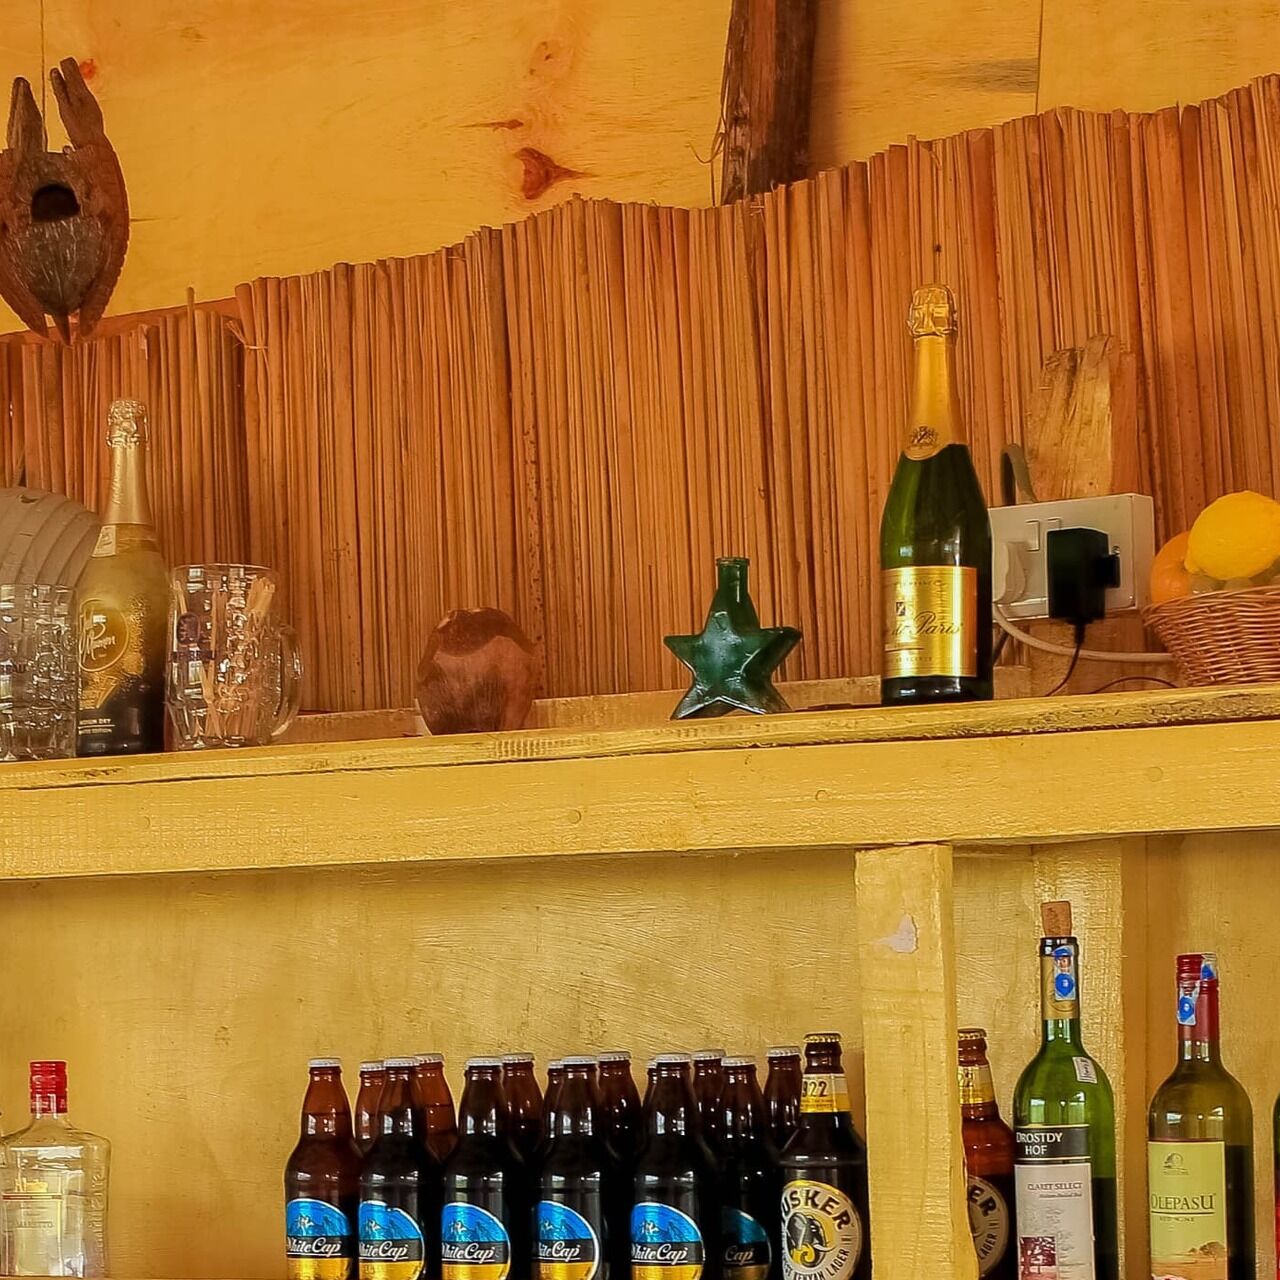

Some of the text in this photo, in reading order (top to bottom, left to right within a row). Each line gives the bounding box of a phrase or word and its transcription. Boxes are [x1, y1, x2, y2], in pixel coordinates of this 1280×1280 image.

[914, 610, 963, 636] Paris
[1016, 1132, 1063, 1144] DROSTDY
[1025, 1144, 1048, 1156] HOF
[781, 1188, 852, 1230] USKER
[827, 1247, 851, 1277] LAGER
